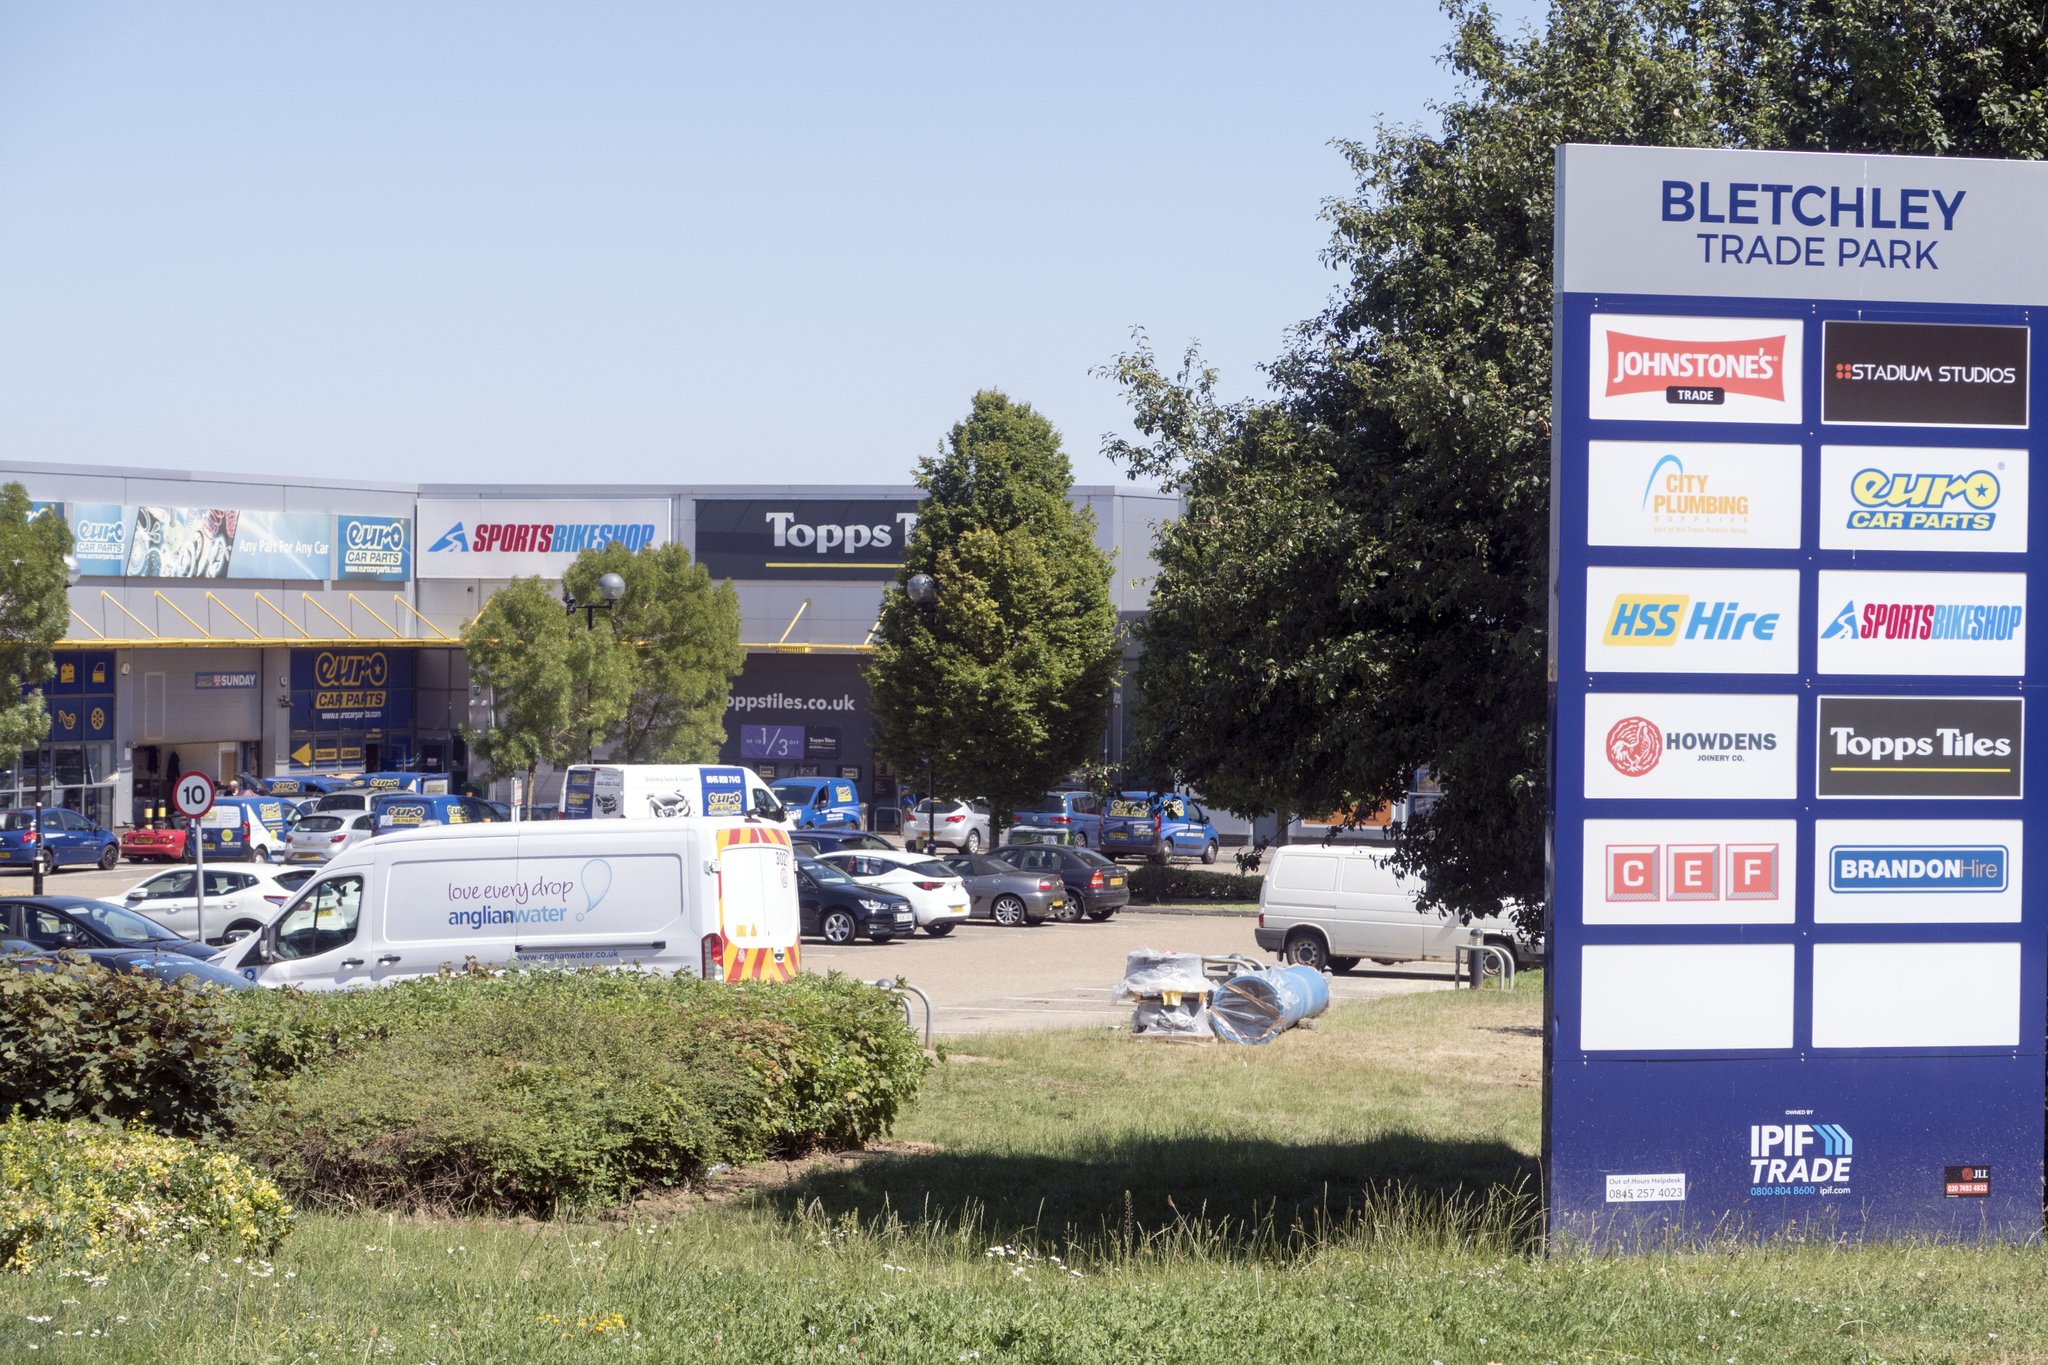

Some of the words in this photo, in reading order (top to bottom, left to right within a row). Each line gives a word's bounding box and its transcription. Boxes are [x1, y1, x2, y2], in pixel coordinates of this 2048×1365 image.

[1662, 180, 1967, 231] BLETCHLEY
[1697, 233, 1826, 267] TRADE
[1838, 238, 1939, 270] PARK
[1612, 347, 1774, 384] JOHNSTONE'S
[1851, 363, 1933, 382] STADIUM
[1938, 366, 2016, 384] STUDIOS
[1677, 389, 1714, 401] TRADE
[1666, 474, 1709, 494] CITY
[1851, 468, 2000, 510] euro
[1653, 494, 1749, 515] PLUMBING
[1852, 512, 1904, 528] CAR
[1909, 513, 1990, 529] PARTS
[77, 520, 126, 543] euro
[347, 520, 404, 551] euro
[472, 524, 655, 553] SPORTSBIKESHOP
[765, 512, 893, 554] Topps
[79, 543, 95, 552] CAR
[96, 543, 123, 553] PARTS
[239, 539, 257, 557] Any
[259, 539, 278, 554] Part
[279, 540, 294, 554] For
[296, 541, 313, 558] Any
[314, 541, 329, 555] Car
[348, 551, 367, 563] CAR
[369, 552, 400, 564] PARTS
[1610, 603, 1680, 637] HSS
[1685, 601, 1780, 641] Hire
[1860, 602, 2023, 641] SPORTSBIKESHOP
[221, 674, 256, 687] SUNDAY
[315, 652, 388, 688] euro
[319, 693, 344, 707] CAR
[345, 692, 384, 706] PARTS
[727, 693, 856, 712] oppstiles.co.uk
[1665, 732, 1777, 752] HOWDENS
[1829, 727, 1934, 761] Topps
[1935, 728, 2012, 756] Tiles
[1697, 754, 1731, 762] JOINERY
[183, 785, 206, 805] 10
[387, 806, 425, 817] euro
[1840, 858, 1998, 880] BRANDONHire
[448, 881, 479, 902] love
[480, 881, 529, 905] every
[531, 876, 574, 902] drop
[448, 905, 567, 929] anglianwater
[1751, 1124, 1814, 1157] IPIF
[1750, 1158, 1852, 1184] TRADE
[1973, 1169, 1988, 1178] JLL
[1609, 1189, 1634, 1199] 0845
[1636, 1188, 1655, 1198] 257
[1658, 1187, 1683, 1198] 4023
[1751, 1187, 1773, 1196] 0800
[1774, 1186, 1791, 1196] 804
[1793, 1186, 1815, 1195] 8600
[1819, 1186, 1850, 1196] ipif.com
